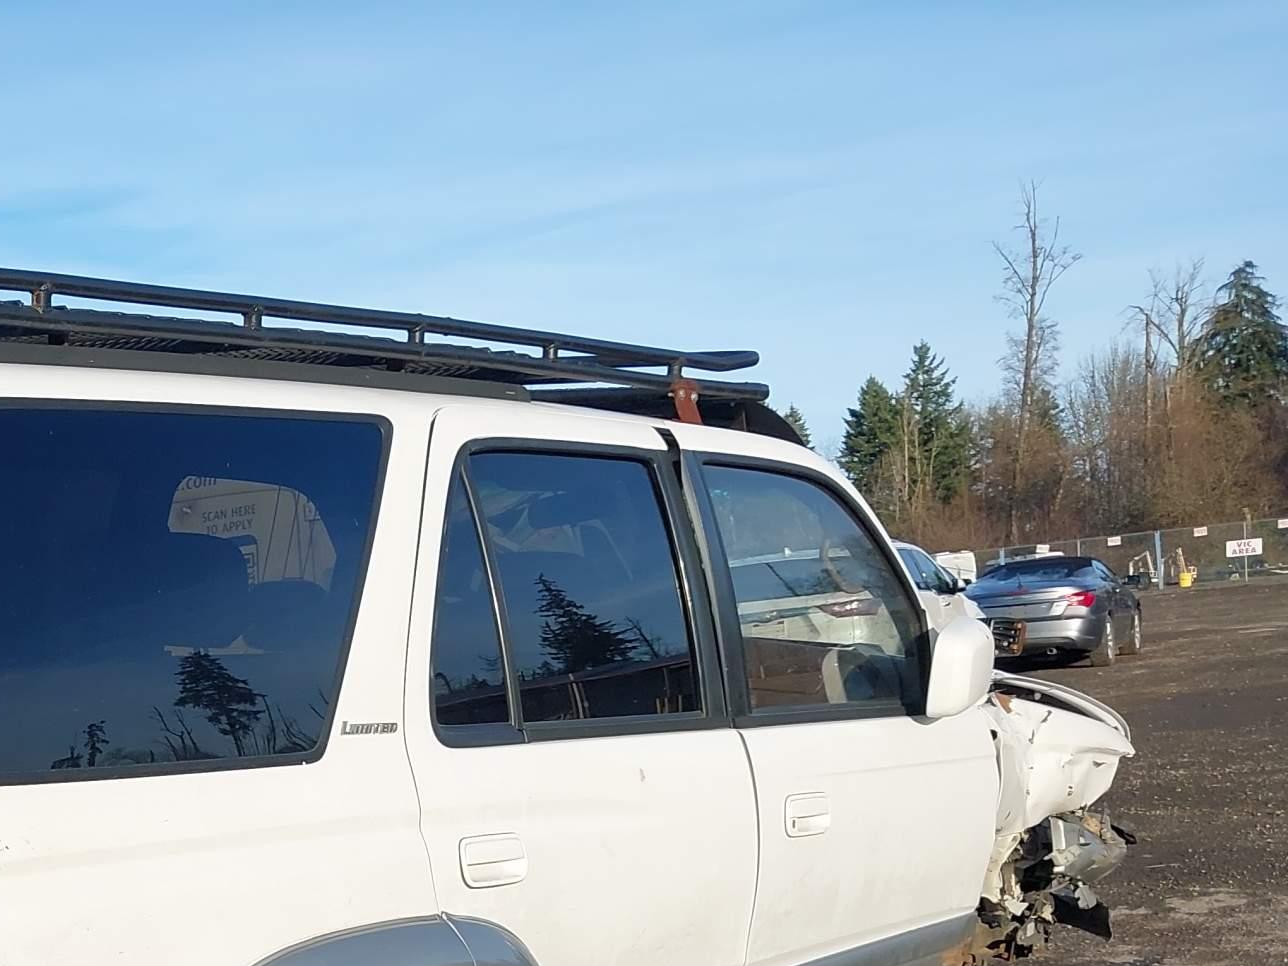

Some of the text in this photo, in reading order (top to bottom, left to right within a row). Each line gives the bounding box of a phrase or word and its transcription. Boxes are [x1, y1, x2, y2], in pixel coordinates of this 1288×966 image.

[201, 503, 256, 523] SCAN HERE
[222, 518, 253, 533] APPLY
[1236, 540, 1252, 548] VIC
[1231, 546, 1257, 555] AREA
